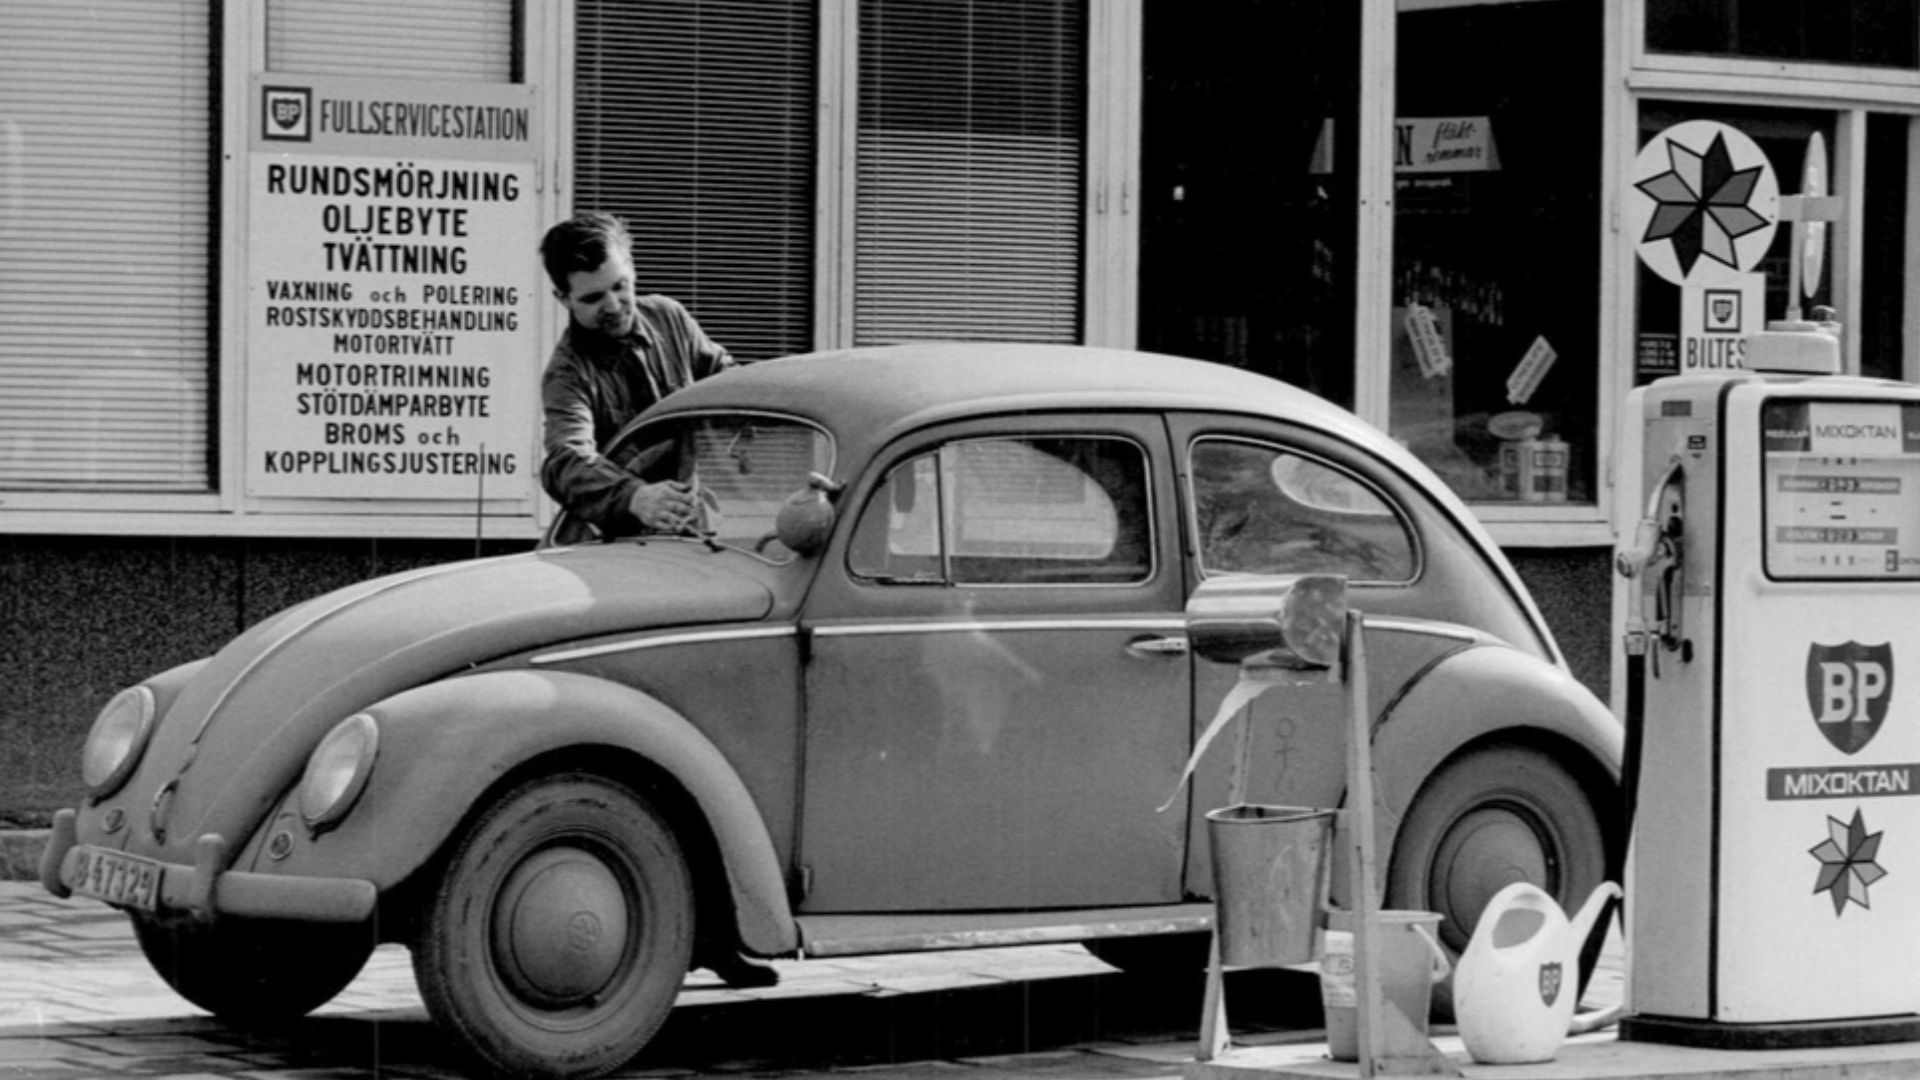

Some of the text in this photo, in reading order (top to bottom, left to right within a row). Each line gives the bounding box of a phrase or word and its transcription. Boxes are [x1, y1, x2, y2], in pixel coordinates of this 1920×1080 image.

[277, 99, 528, 141] BP FULLSERVICESTATION
[267, 162, 520, 201] RUNDSMÖRJNING
[323, 205, 468, 237] OLJEBYTE
[323, 235, 468, 274] TVÄTTNING
[266, 281, 518, 305] VAXNING och POLERING
[266, 306, 518, 333] ROSTSKYDDSBEHANDLING
[333, 331, 455, 355] MOTORTVÄTT
[296, 363, 490, 388] MOTORTRIMNING
[297, 388, 490, 417] STÖTDÄMPARBYTE
[325, 422, 459, 445] BROMS och
[265, 450, 516, 477] KOPPLINGSJUSTERING
[1819, 661, 1886, 723] BP
[1784, 769, 1909, 796] MIXOKTAN
